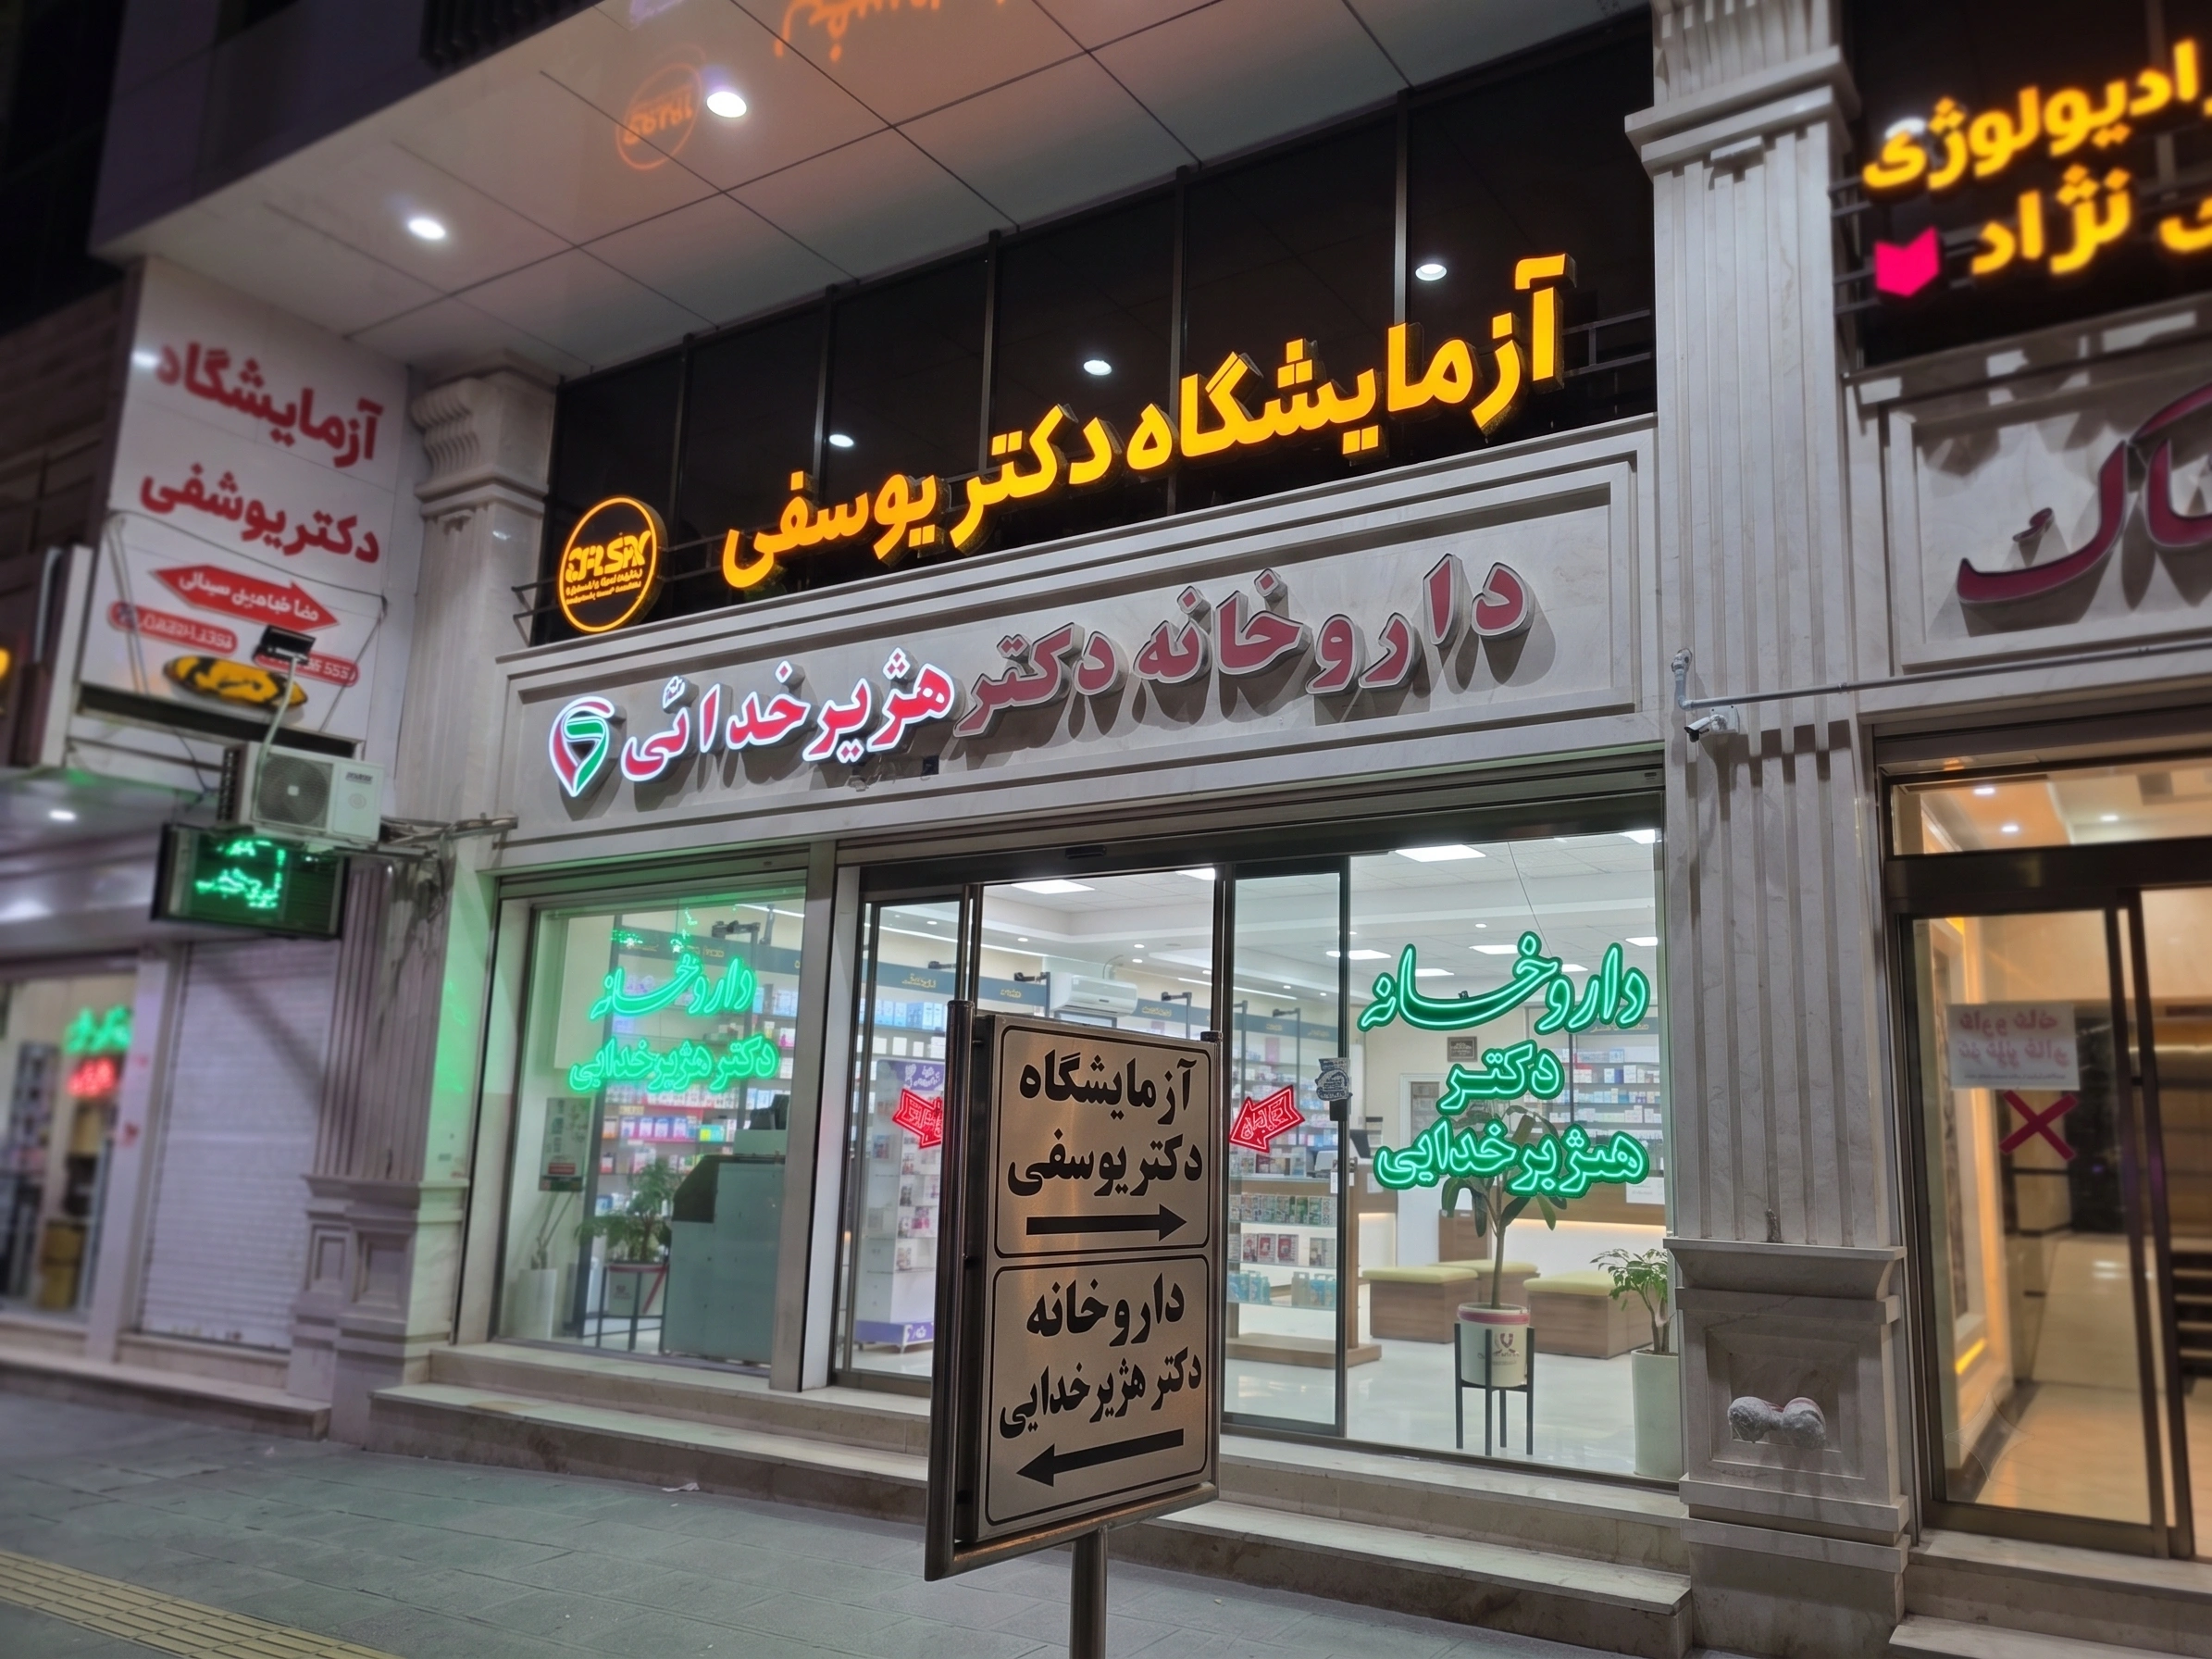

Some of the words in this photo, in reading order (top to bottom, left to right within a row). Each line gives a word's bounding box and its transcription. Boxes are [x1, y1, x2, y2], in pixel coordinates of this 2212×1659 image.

[1862, 39, 2212, 191] ادیولوژی
[1970, 164, 2131, 275] نژاد
[1126, 253, 1568, 470] آزمایشگاه
[951, 404, 1114, 550] دکتر
[282, 510, 379, 564] دکتر
[722, 469, 938, 589] یوسفی
[1133, 554, 1533, 695] داروخانه
[953, 622, 1118, 738] دکتر
[590, 952, 756, 1021] داروخانه
[1358, 931, 1650, 1035] داروخانه
[569, 1037, 659, 1091] خدایی
[709, 1034, 778, 1091] دکتر
[1019, 1050, 1198, 1125] آزمایشگاه
[1436, 1040, 1564, 1115] دکتر
[1007, 1128, 1128, 1197] یوسفی
[1131, 1133, 1203, 1196] دکتر
[1373, 1116, 1519, 1190] خدایی
[1025, 1272, 1186, 1348] داروخانه
[999, 1361, 1091, 1440] خدایی
[1088, 1357, 1147, 1424] هژیر
[1150, 1345, 1202, 1412] دکتر
